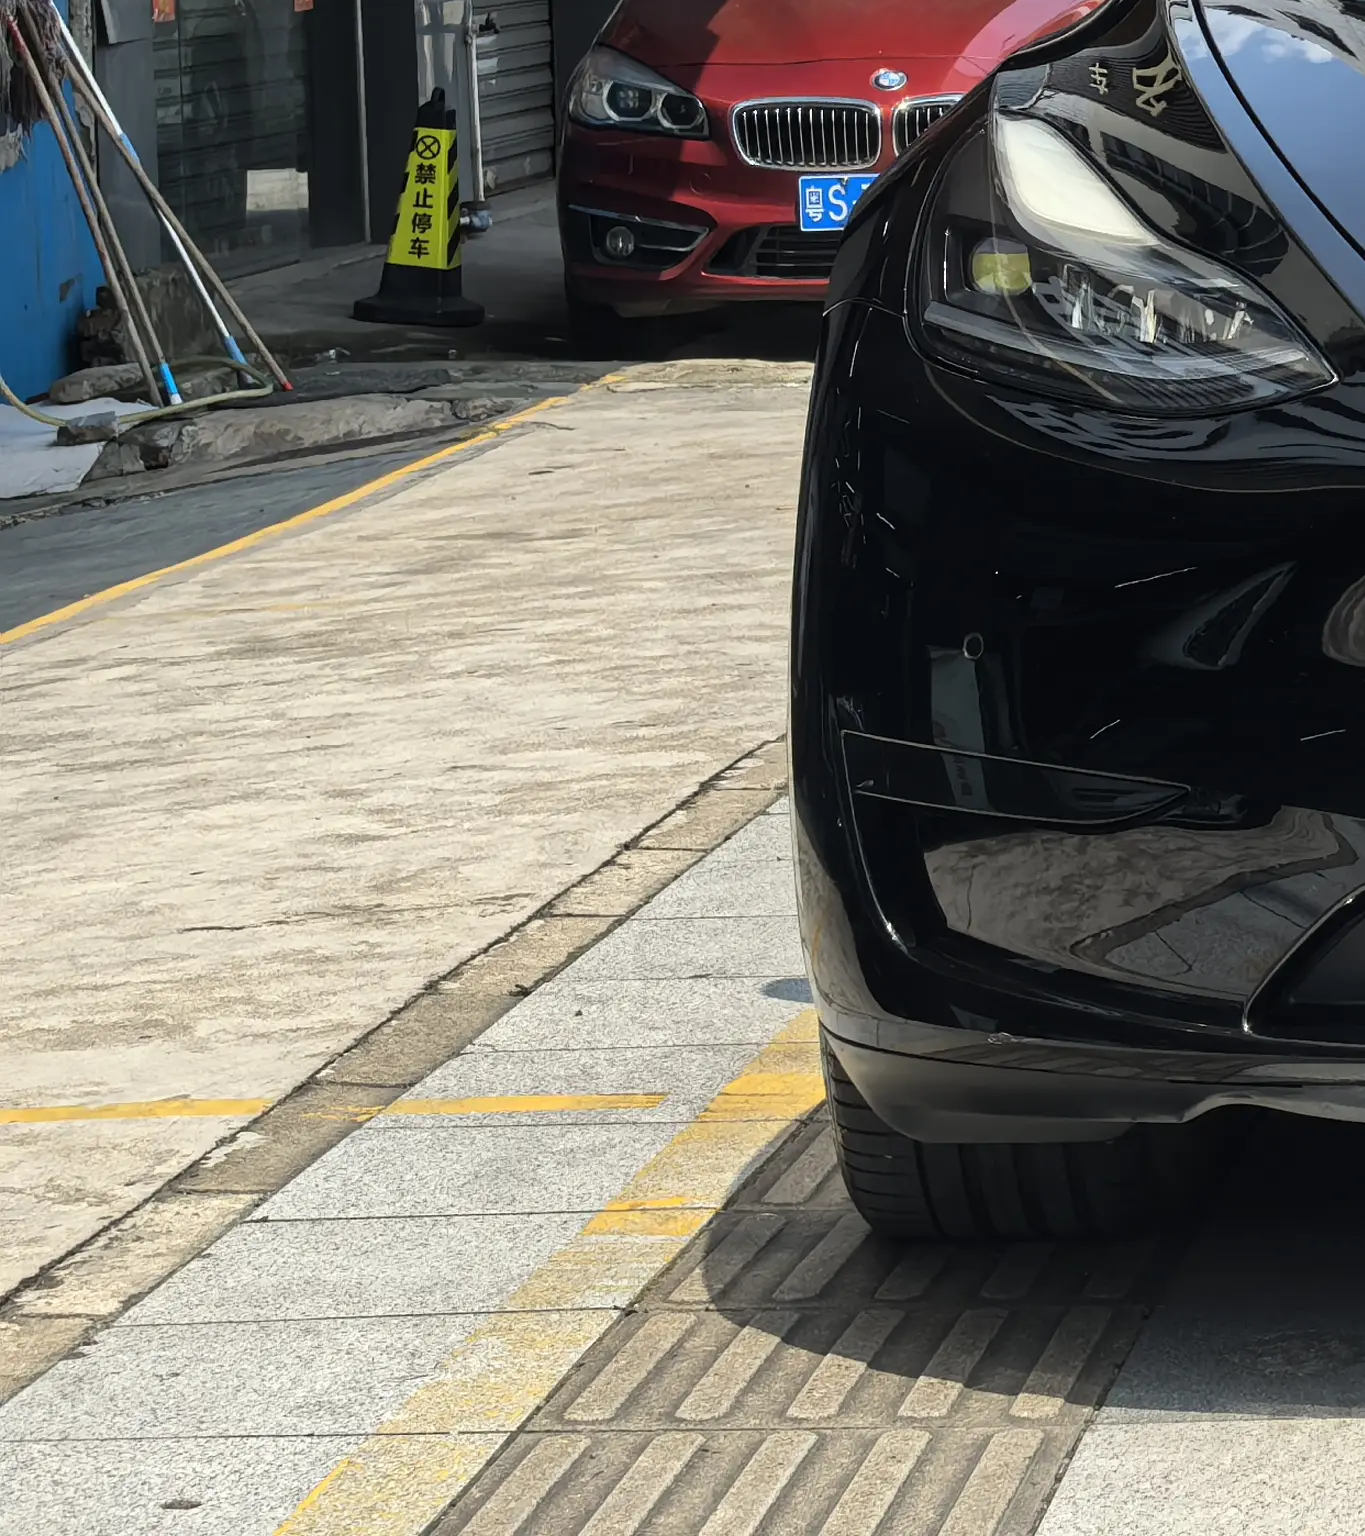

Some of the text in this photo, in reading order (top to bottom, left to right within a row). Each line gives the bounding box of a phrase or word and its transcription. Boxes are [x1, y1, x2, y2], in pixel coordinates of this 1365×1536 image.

[408, 162, 437, 260] 禁止停车
[805, 183, 871, 223] 粤S
